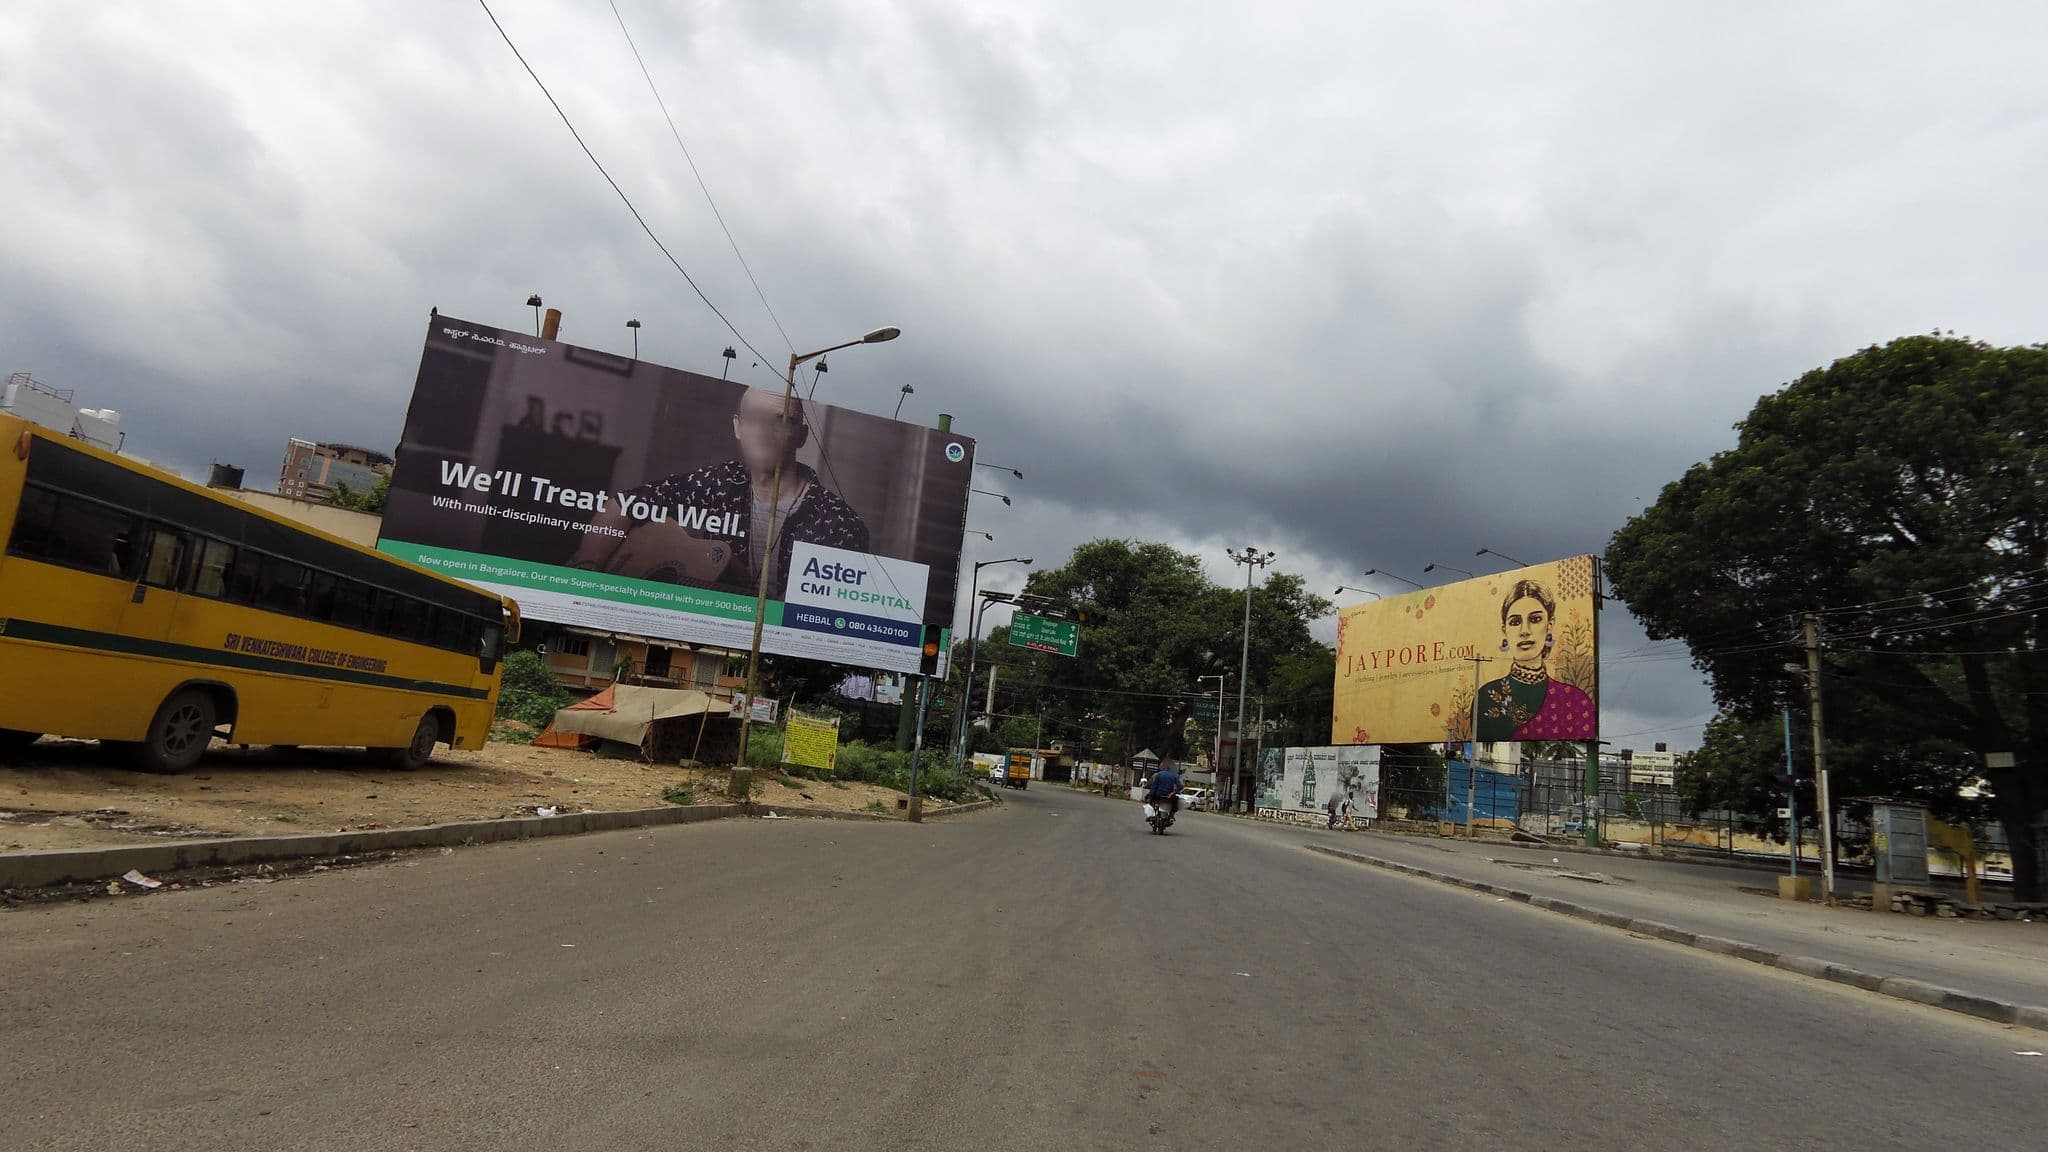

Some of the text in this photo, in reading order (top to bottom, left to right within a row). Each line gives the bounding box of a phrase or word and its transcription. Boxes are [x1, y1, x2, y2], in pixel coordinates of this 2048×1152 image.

[432, 495, 627, 538] With multi-disciplinary expertise.
[441, 460, 746, 538] We'll Treat You Well.
[418, 554, 754, 613] Now open in Bangalore. Our new Super-specialty hospital with over 500 beds.
[802, 557, 867, 586] Aster
[800, 582, 912, 611] CMI HOSPITAL
[796, 612, 909, 638] HEBBAL 080 43420100
[224, 632, 241, 650] SRI
[308, 647, 338, 666] COLLEGE
[337, 653, 347, 667] OF
[347, 655, 388, 674] ENGINEERING
[1344, 641, 1474, 677] JAYPORE.COM
